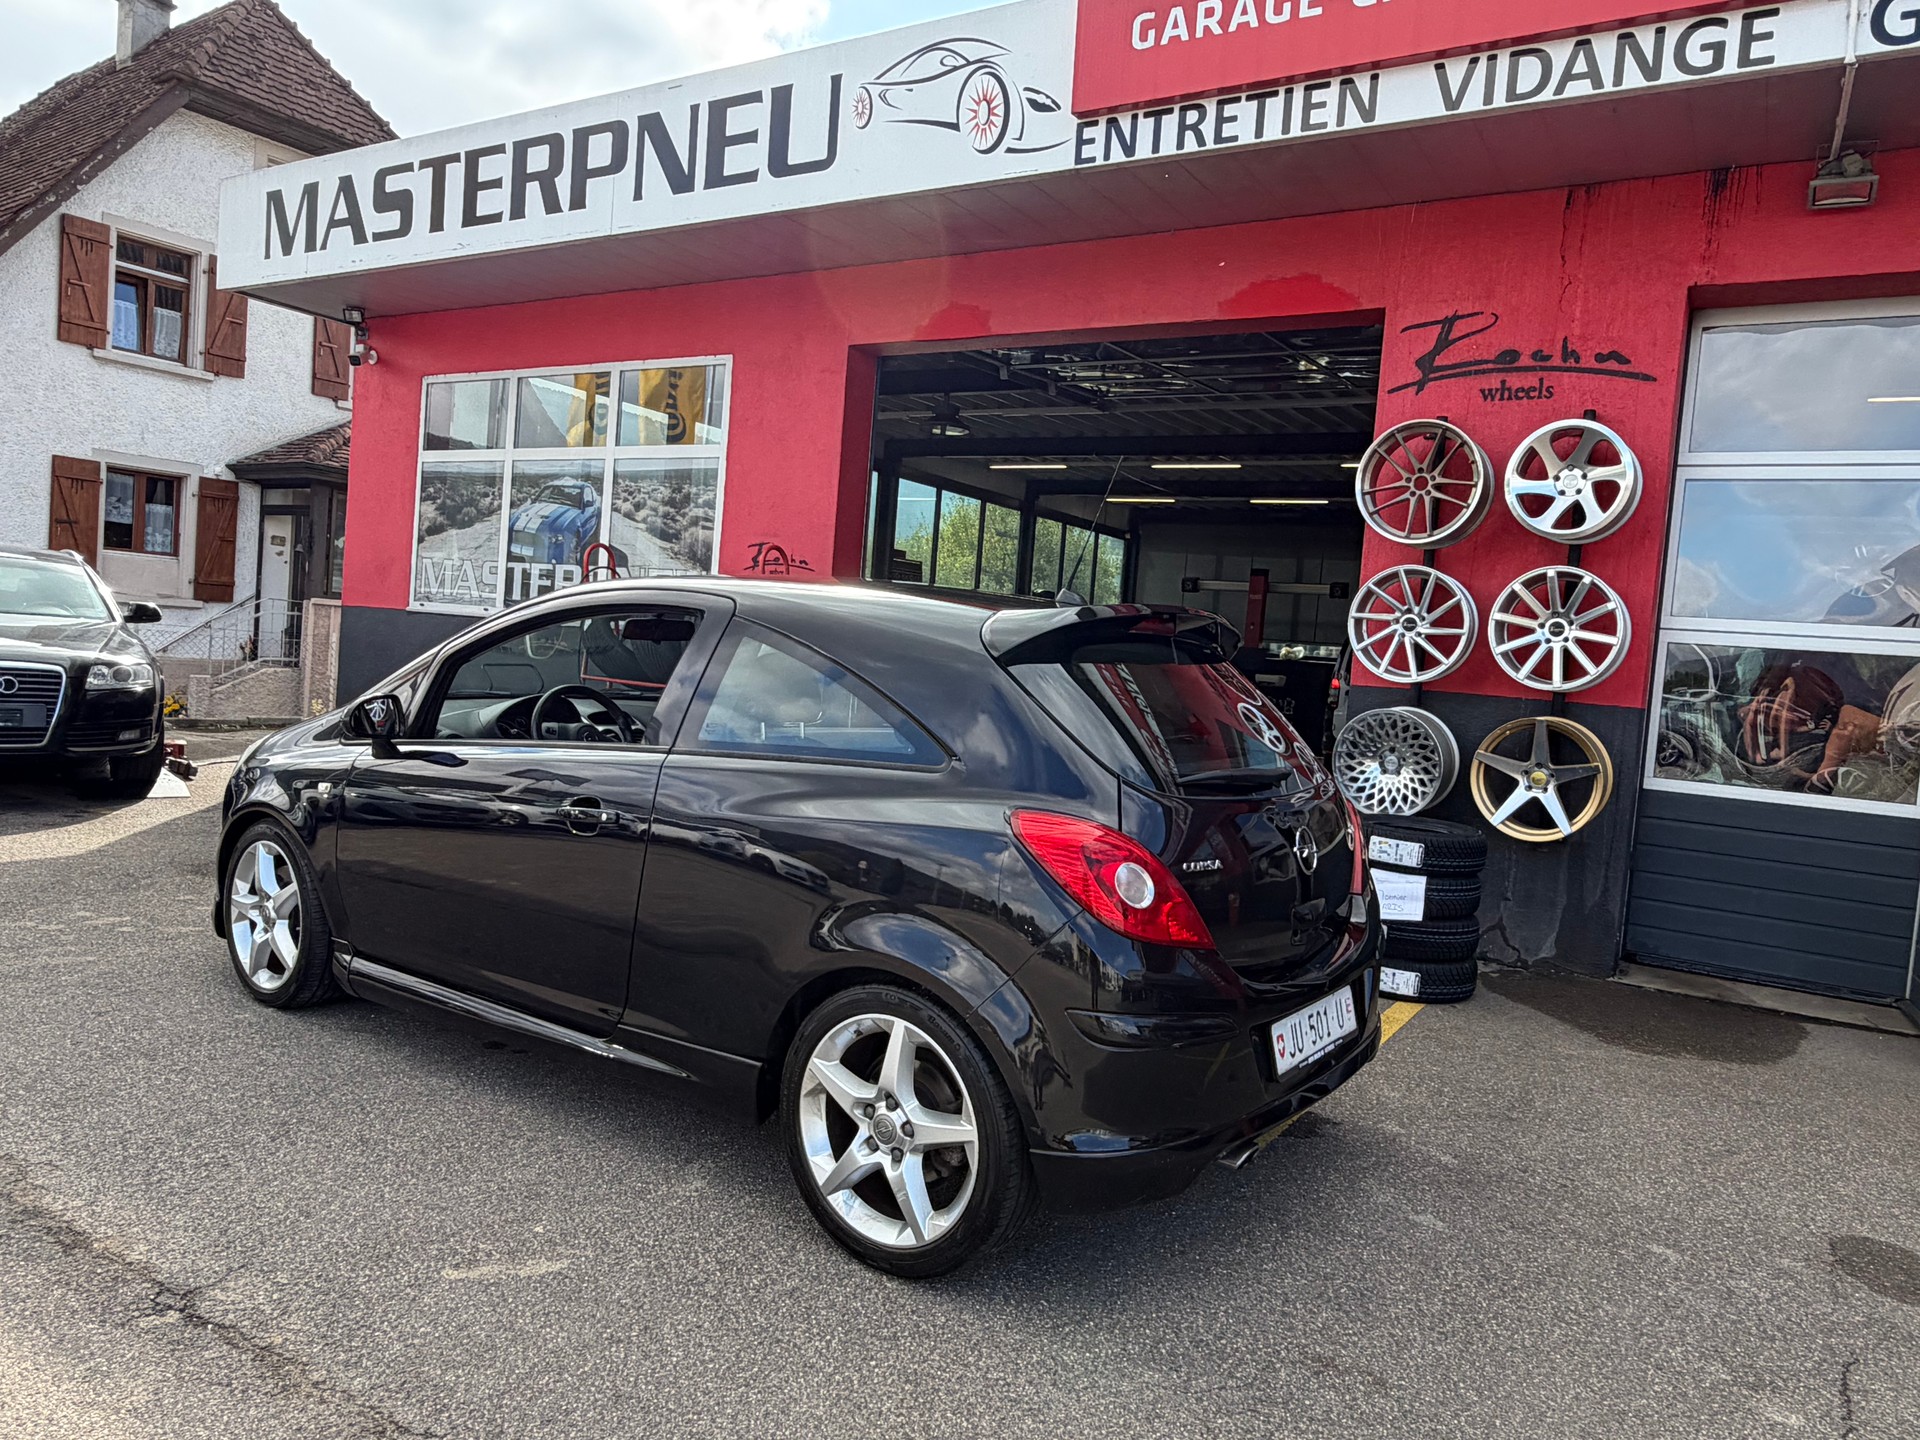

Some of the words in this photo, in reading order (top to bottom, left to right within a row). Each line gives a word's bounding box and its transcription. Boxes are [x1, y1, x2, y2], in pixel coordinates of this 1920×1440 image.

[264, 72, 844, 261] MASTERPNEU
[1073, 72, 1381, 167] ENTRETIEN
[1433, 7, 1781, 112] VIDANGE
[1479, 377, 1555, 402] wheels
